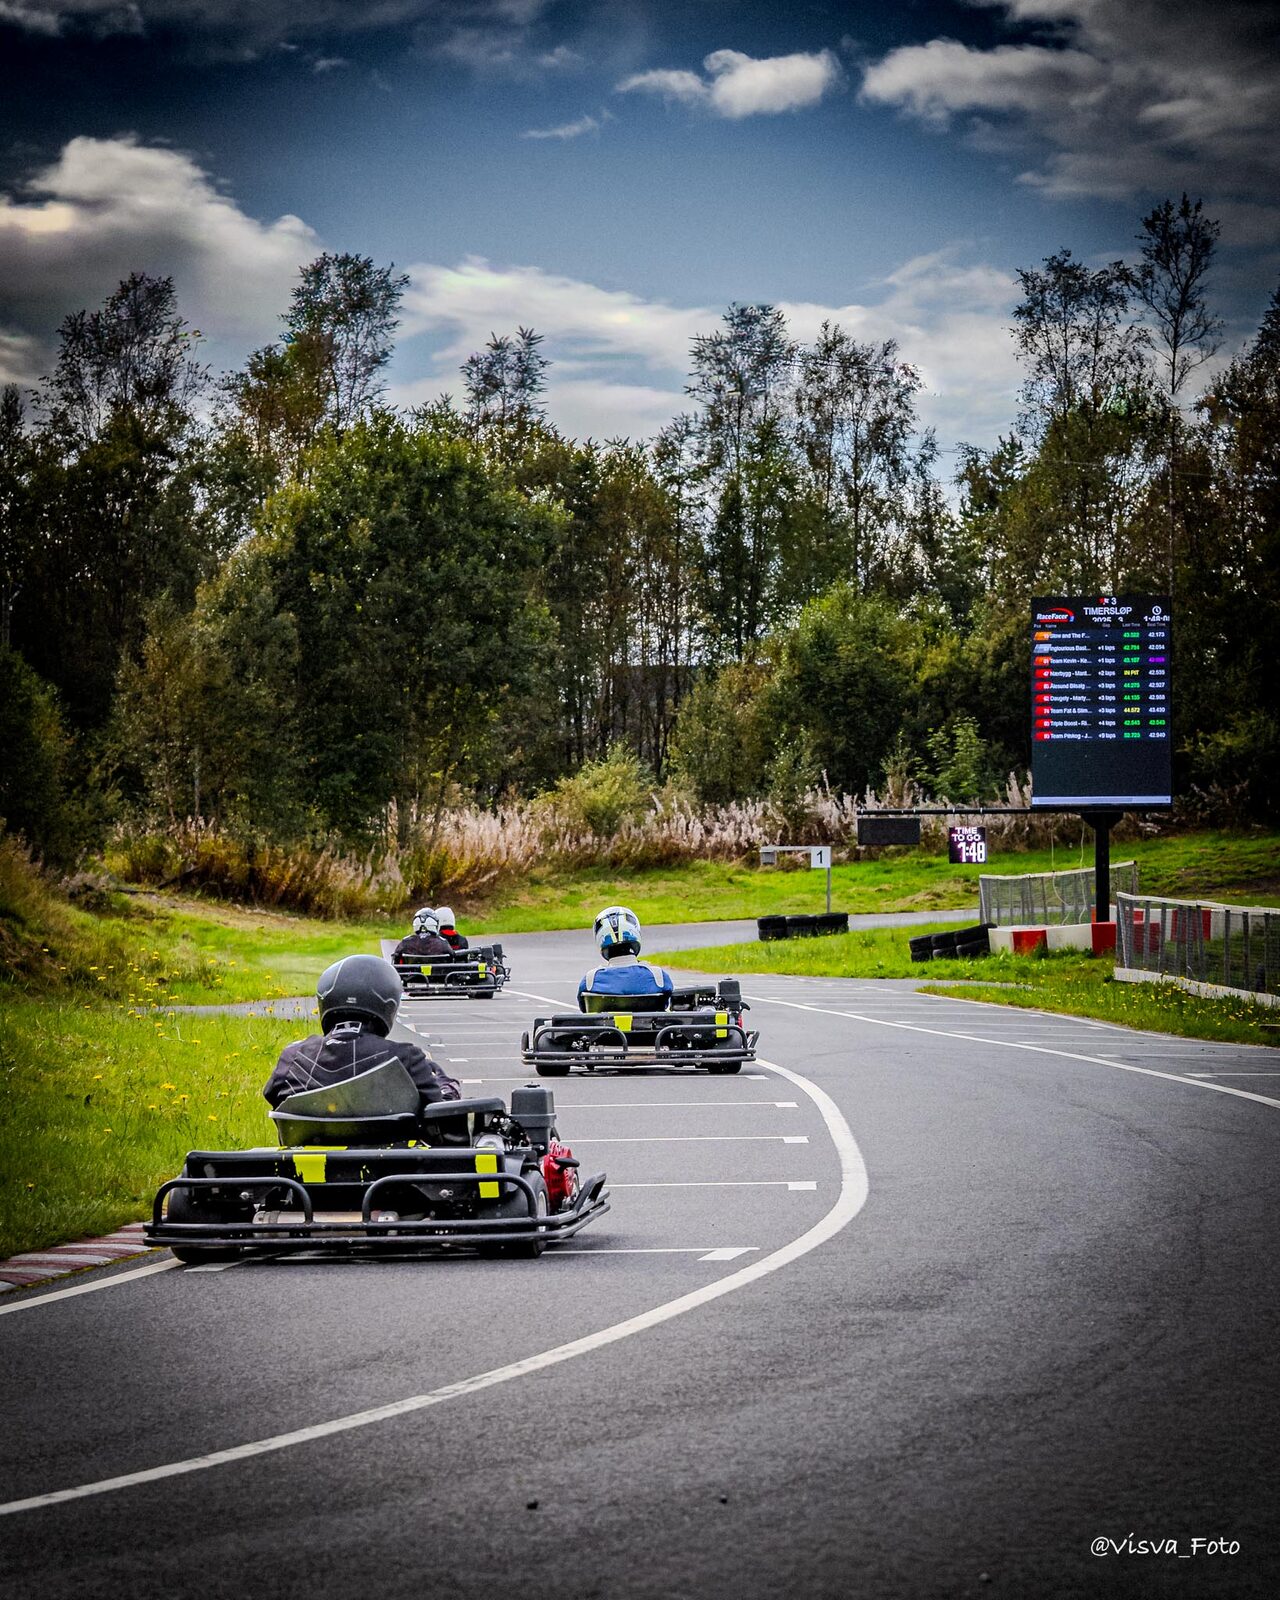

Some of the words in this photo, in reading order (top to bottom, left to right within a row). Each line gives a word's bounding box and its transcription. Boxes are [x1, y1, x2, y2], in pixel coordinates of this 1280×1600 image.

[1111, 597, 1117, 605] 3
[1083, 607, 1132, 615] TIMERSLØP
[952, 833, 965, 842] TO
[966, 833, 981, 842] GO
[957, 841, 986, 863] 1:48
[816, 850, 824, 864] 1
